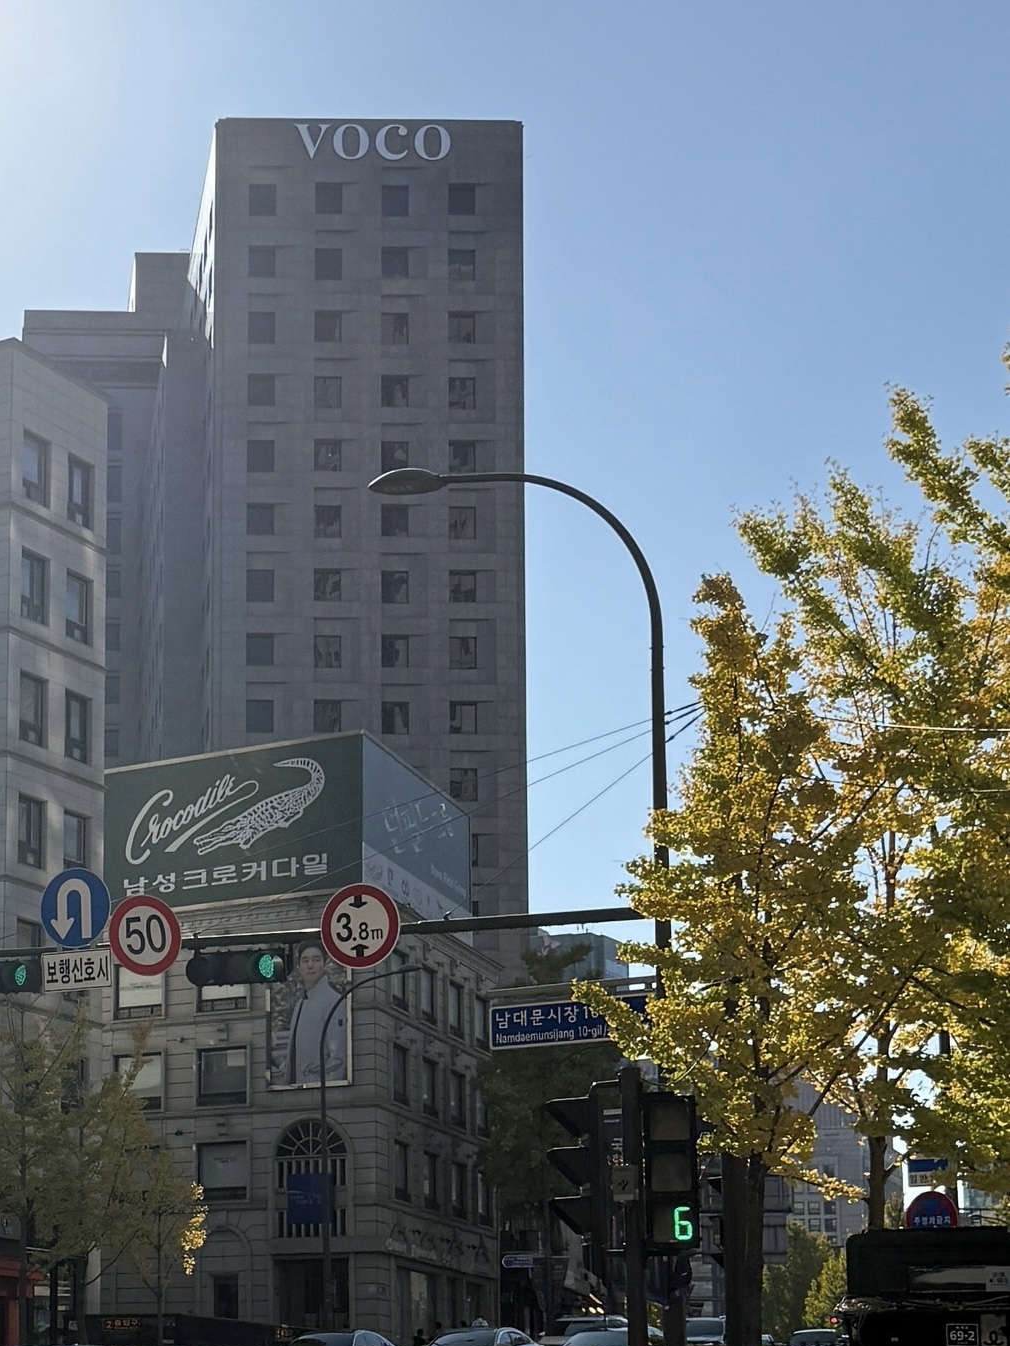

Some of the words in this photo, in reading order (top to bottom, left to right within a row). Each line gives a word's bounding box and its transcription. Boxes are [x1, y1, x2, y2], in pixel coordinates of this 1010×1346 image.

[293, 124, 451, 160] VOCO
[125, 774, 258, 864] Crocodile
[182, 853, 328, 890] 크로커다일
[126, 914, 166, 955] 50
[336, 913, 383, 942] 3.8m
[47, 956, 109, 984] 보행신호시
[495, 1004, 578, 1029] 남대문시장
[496, 1028, 575, 1044] Namdaemunsijang
[673, 1205, 693, 1241] 6
[950, 1330, 976, 1341] 69-2
